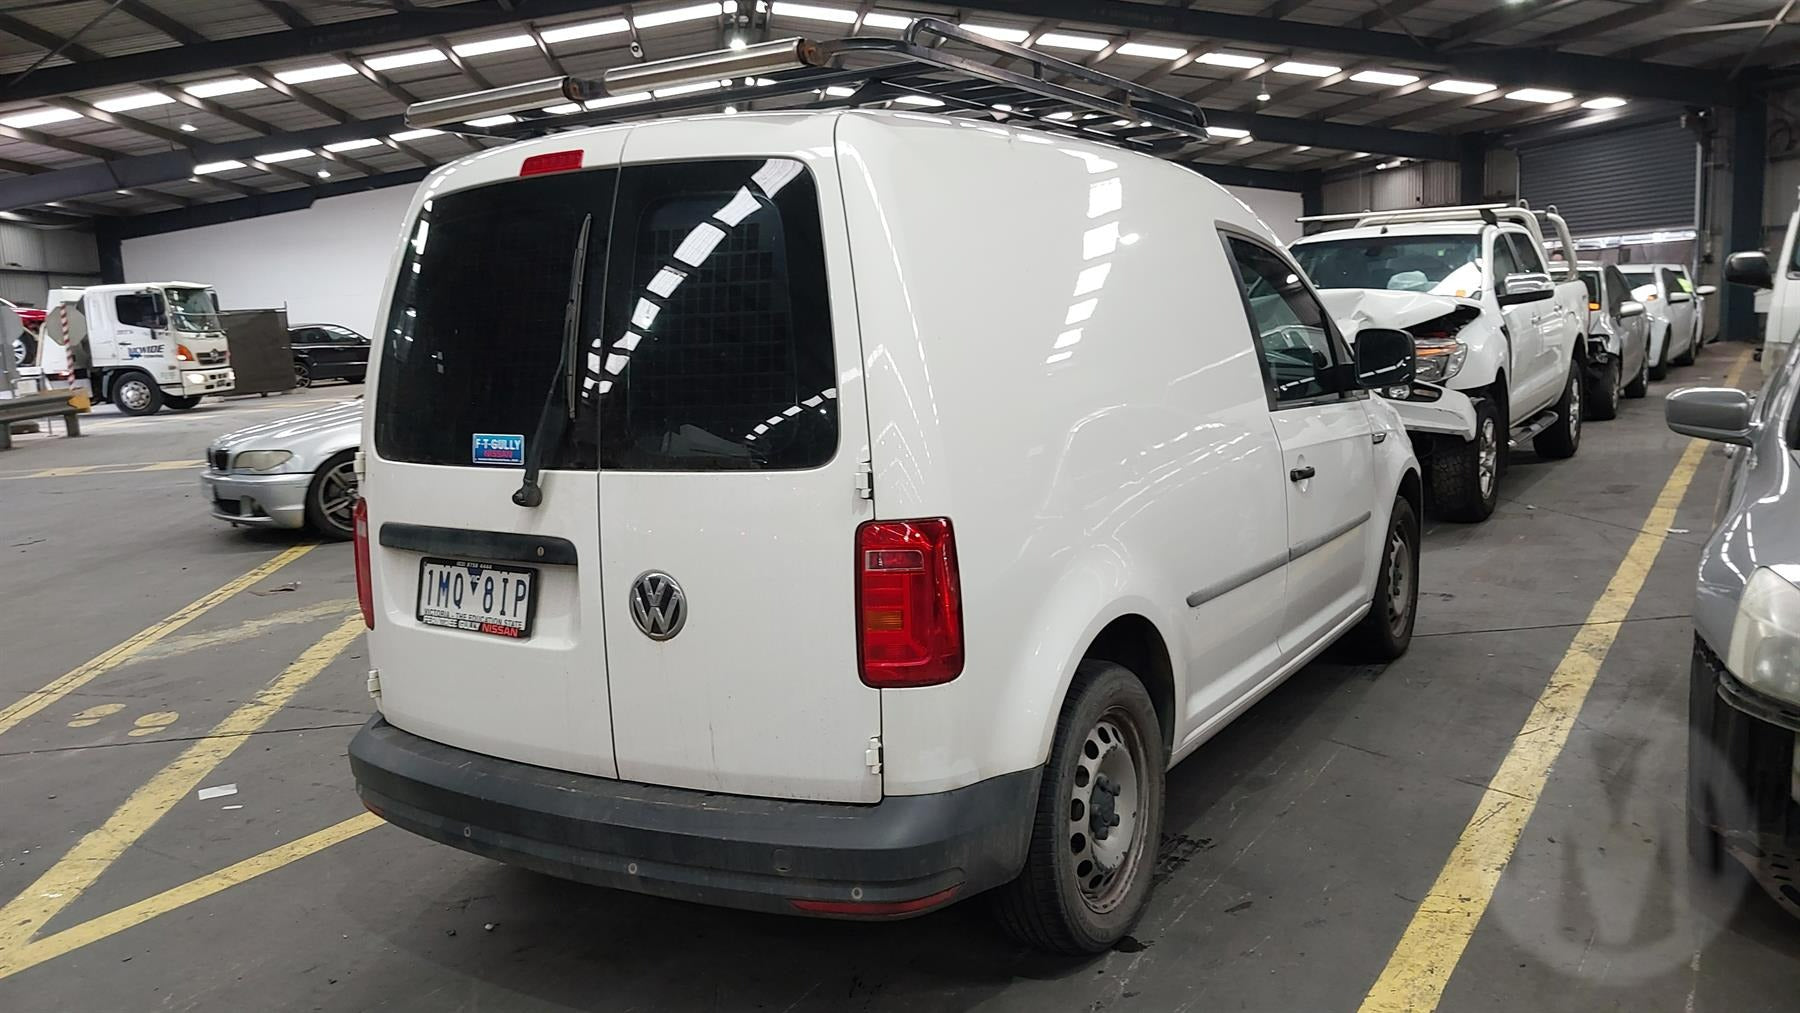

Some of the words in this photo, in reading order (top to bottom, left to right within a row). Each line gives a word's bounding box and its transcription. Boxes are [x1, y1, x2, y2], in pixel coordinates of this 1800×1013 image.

[427, 569, 464, 609] 1MQ
[482, 576, 527, 618] 8IP
[424, 608, 449, 618] VICTORIA
[468, 613, 502, 624] EDUCATION
[503, 618, 523, 629] STATE
[481, 622, 518, 637] NISSAN
